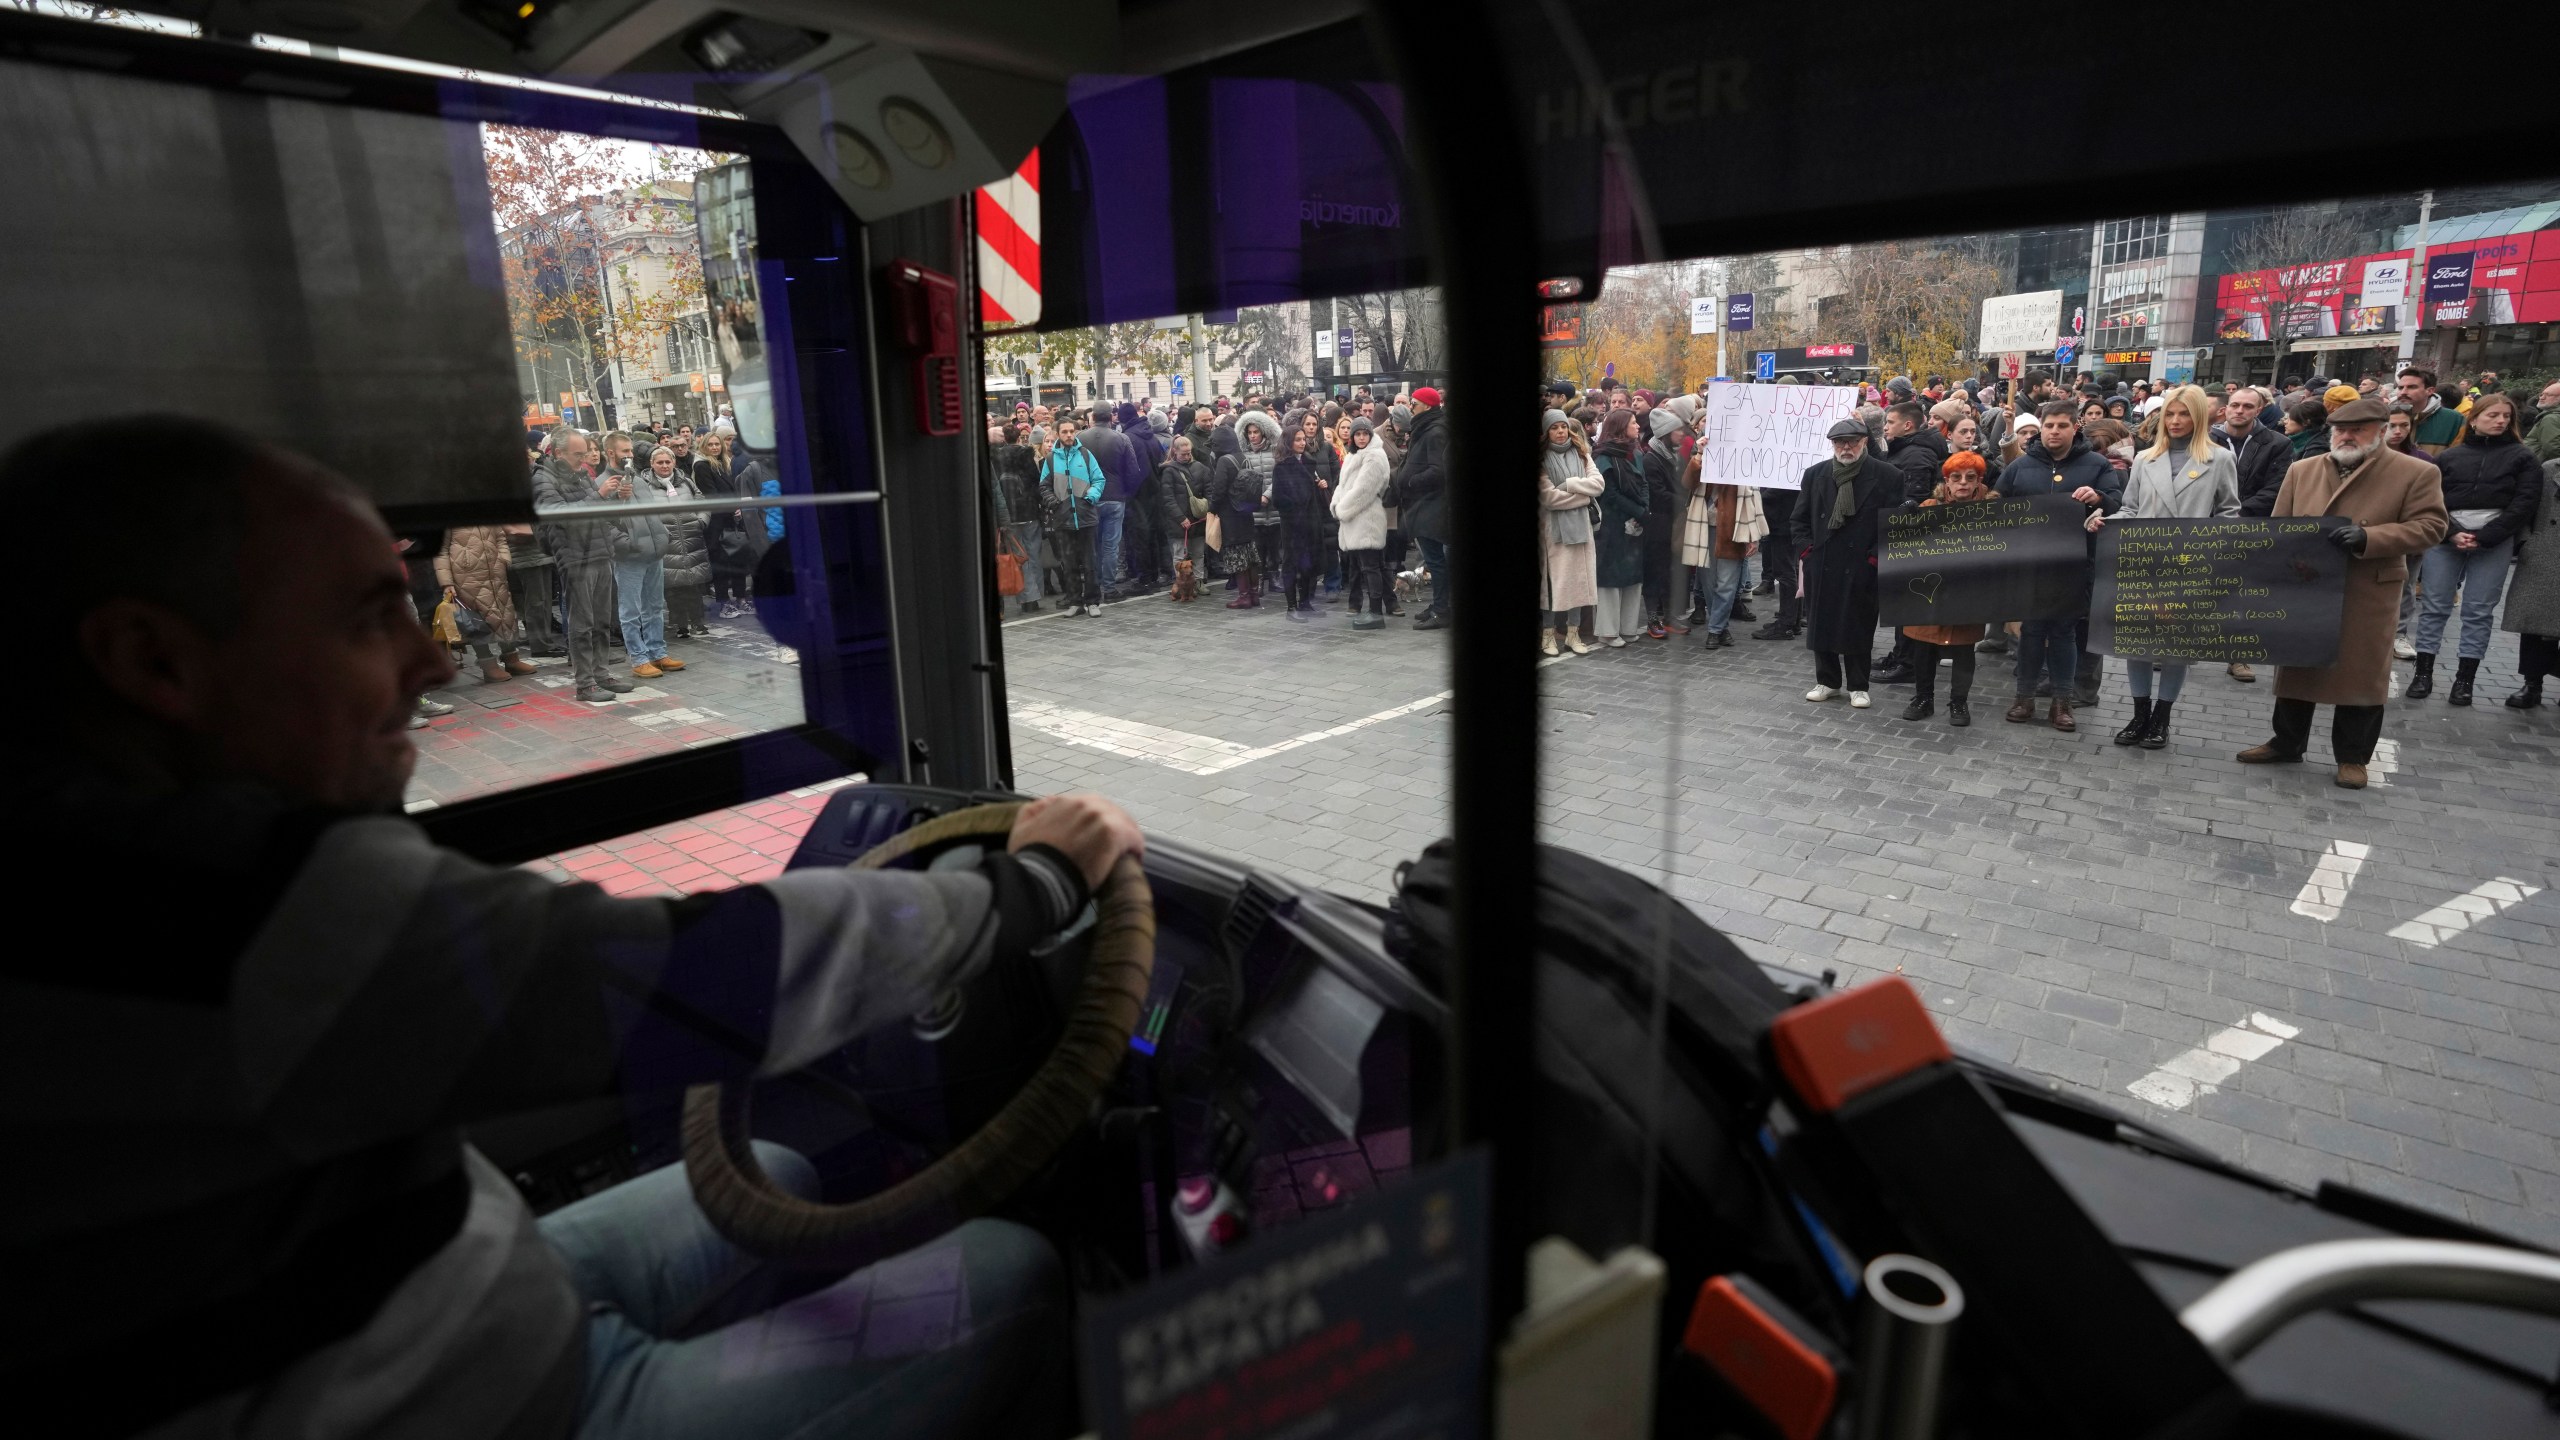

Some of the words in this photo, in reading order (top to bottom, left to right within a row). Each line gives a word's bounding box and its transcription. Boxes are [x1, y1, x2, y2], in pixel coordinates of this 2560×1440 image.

[1533, 56, 1750, 145] HIGER
[2475, 242, 2519, 260] KPOTS
[2279, 263, 2346, 287] WINBET
[2432, 266, 2469, 280] Ford
[2368, 278, 2403, 286] HYUNDAI
[1730, 303, 1752, 314] Ford
[2435, 307, 2470, 321] BOMBE
[2105, 351, 2139, 364] WINBET
[1724, 385, 1755, 411] ЗА
[1770, 386, 1851, 420] ЉУБАВ
[1707, 414, 1740, 443] НЕ
[1748, 414, 1778, 444] ЗА
[1704, 446, 1737, 480] МИ
[1741, 447, 1775, 479] СМО
[1944, 501, 1998, 525] ЂОРЂЕ
[2003, 499, 2031, 514] (1971)
[1888, 526, 1933, 540] ФИРИЋ
[1939, 519, 2014, 534] ВАЛЕНТИНА
[2018, 514, 2049, 526] (2014)
[2119, 527, 2183, 540] МИЛИЦА
[2189, 521, 2270, 537] АДАМОВИЋ
[2278, 522, 2321, 534] (2008)
[1888, 540, 1927, 551] ГОРАНКА
[1934, 538, 1963, 547] РАЦА
[1969, 534, 1994, 544] (1966)
[2119, 541, 2173, 554] НЕМАЊА
[2183, 540, 2228, 550] КОМАР
[2233, 538, 2274, 550] (2007)
[1888, 551, 1914, 561] АЊА
[1917, 545, 1970, 557] РАДОЊИЋ
[1972, 541, 2007, 552] (2000)
[2118, 556, 2154, 568] РУМАН
[2213, 551, 2247, 561] (2004)
[2116, 569, 2150, 579] ФИРИЋ
[2155, 568, 2179, 577] САРА
[2183, 563, 2213, 576] (2018)
[2117, 581, 2154, 591] МИЛЕВА
[2158, 577, 2211, 589] КАРАНОВИЋ
[2117, 592, 2142, 602] САЊА
[2182, 588, 2230, 597] АРБУТИНА
[2239, 586, 2269, 598] (1989)
[2115, 602, 2159, 612] СТЕФАН
[2163, 601, 2188, 611] ХРКА
[2115, 613, 2149, 623] МИЛОШ
[2154, 610, 2240, 621] МИЛОСАВЉЕВИЋ
[2245, 608, 2287, 621] (2003)
[2114, 625, 2151, 635] ШВОЊА
[2155, 624, 2187, 636] ЂУРО
[2113, 635, 2166, 645] ВУКАШИН
[2171, 635, 2226, 646] РАКОВИЋ
[2113, 645, 2147, 656] ВАСКО
[2151, 648, 2226, 660] САЗДОВСКИ
[2230, 648, 2268, 662] (1979)
